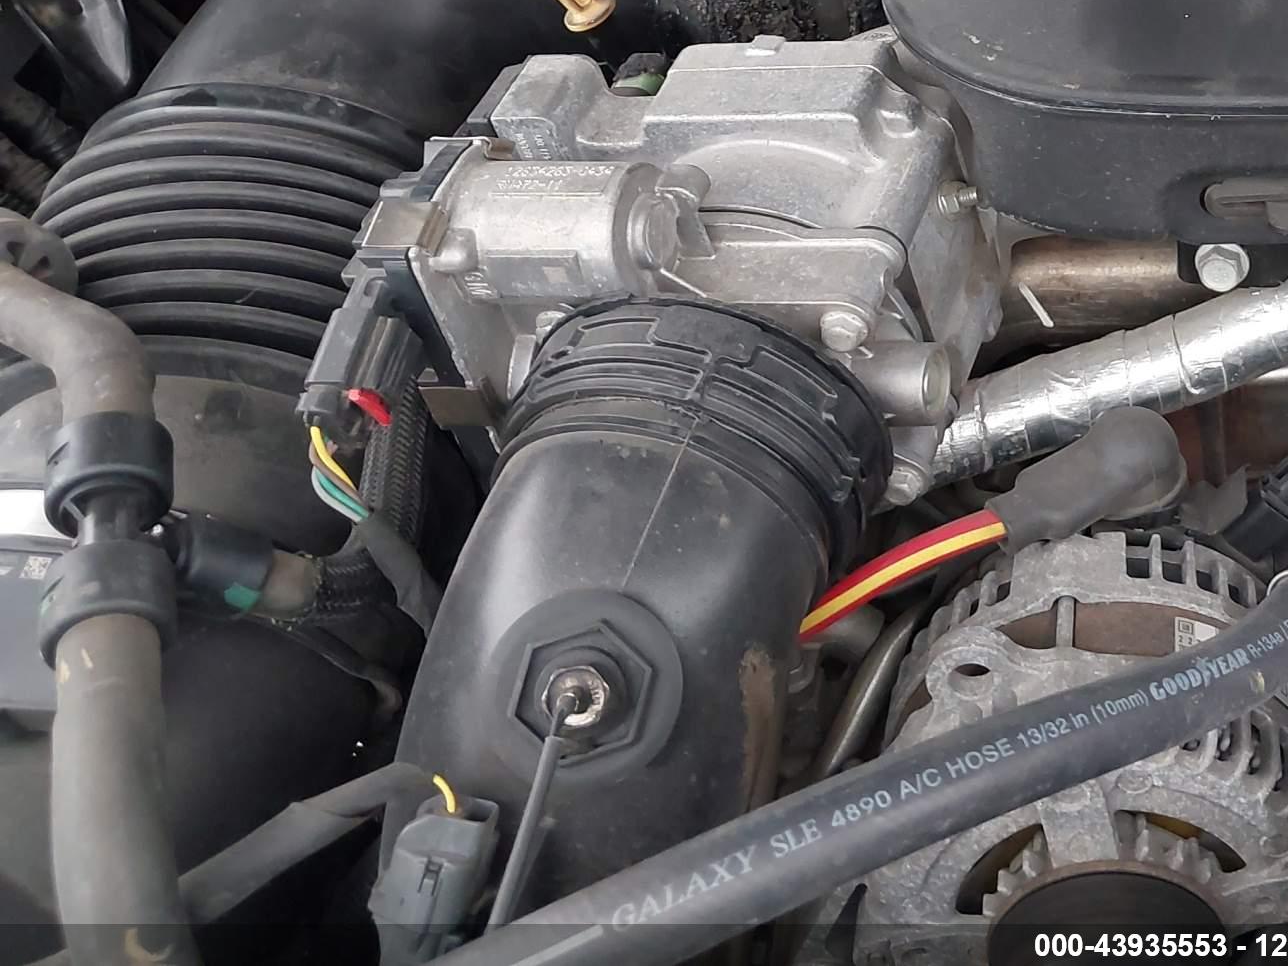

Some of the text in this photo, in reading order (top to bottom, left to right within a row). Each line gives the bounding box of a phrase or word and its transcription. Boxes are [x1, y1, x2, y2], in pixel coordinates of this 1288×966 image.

[612, 844, 757, 932] GALAXY
[769, 818, 823, 859] SLE
[831, 789, 893, 827] 4890
[899, 768, 943, 800] A/C
[945, 738, 1016, 780] HOSE
[1016, 718, 1072, 749] 13/32
[1073, 712, 1090, 730] in
[1091, 689, 1150, 724] (10mm)
[1149, 648, 1251, 701] GOODYEAR
[1246, 630, 1284, 659] R-134a
